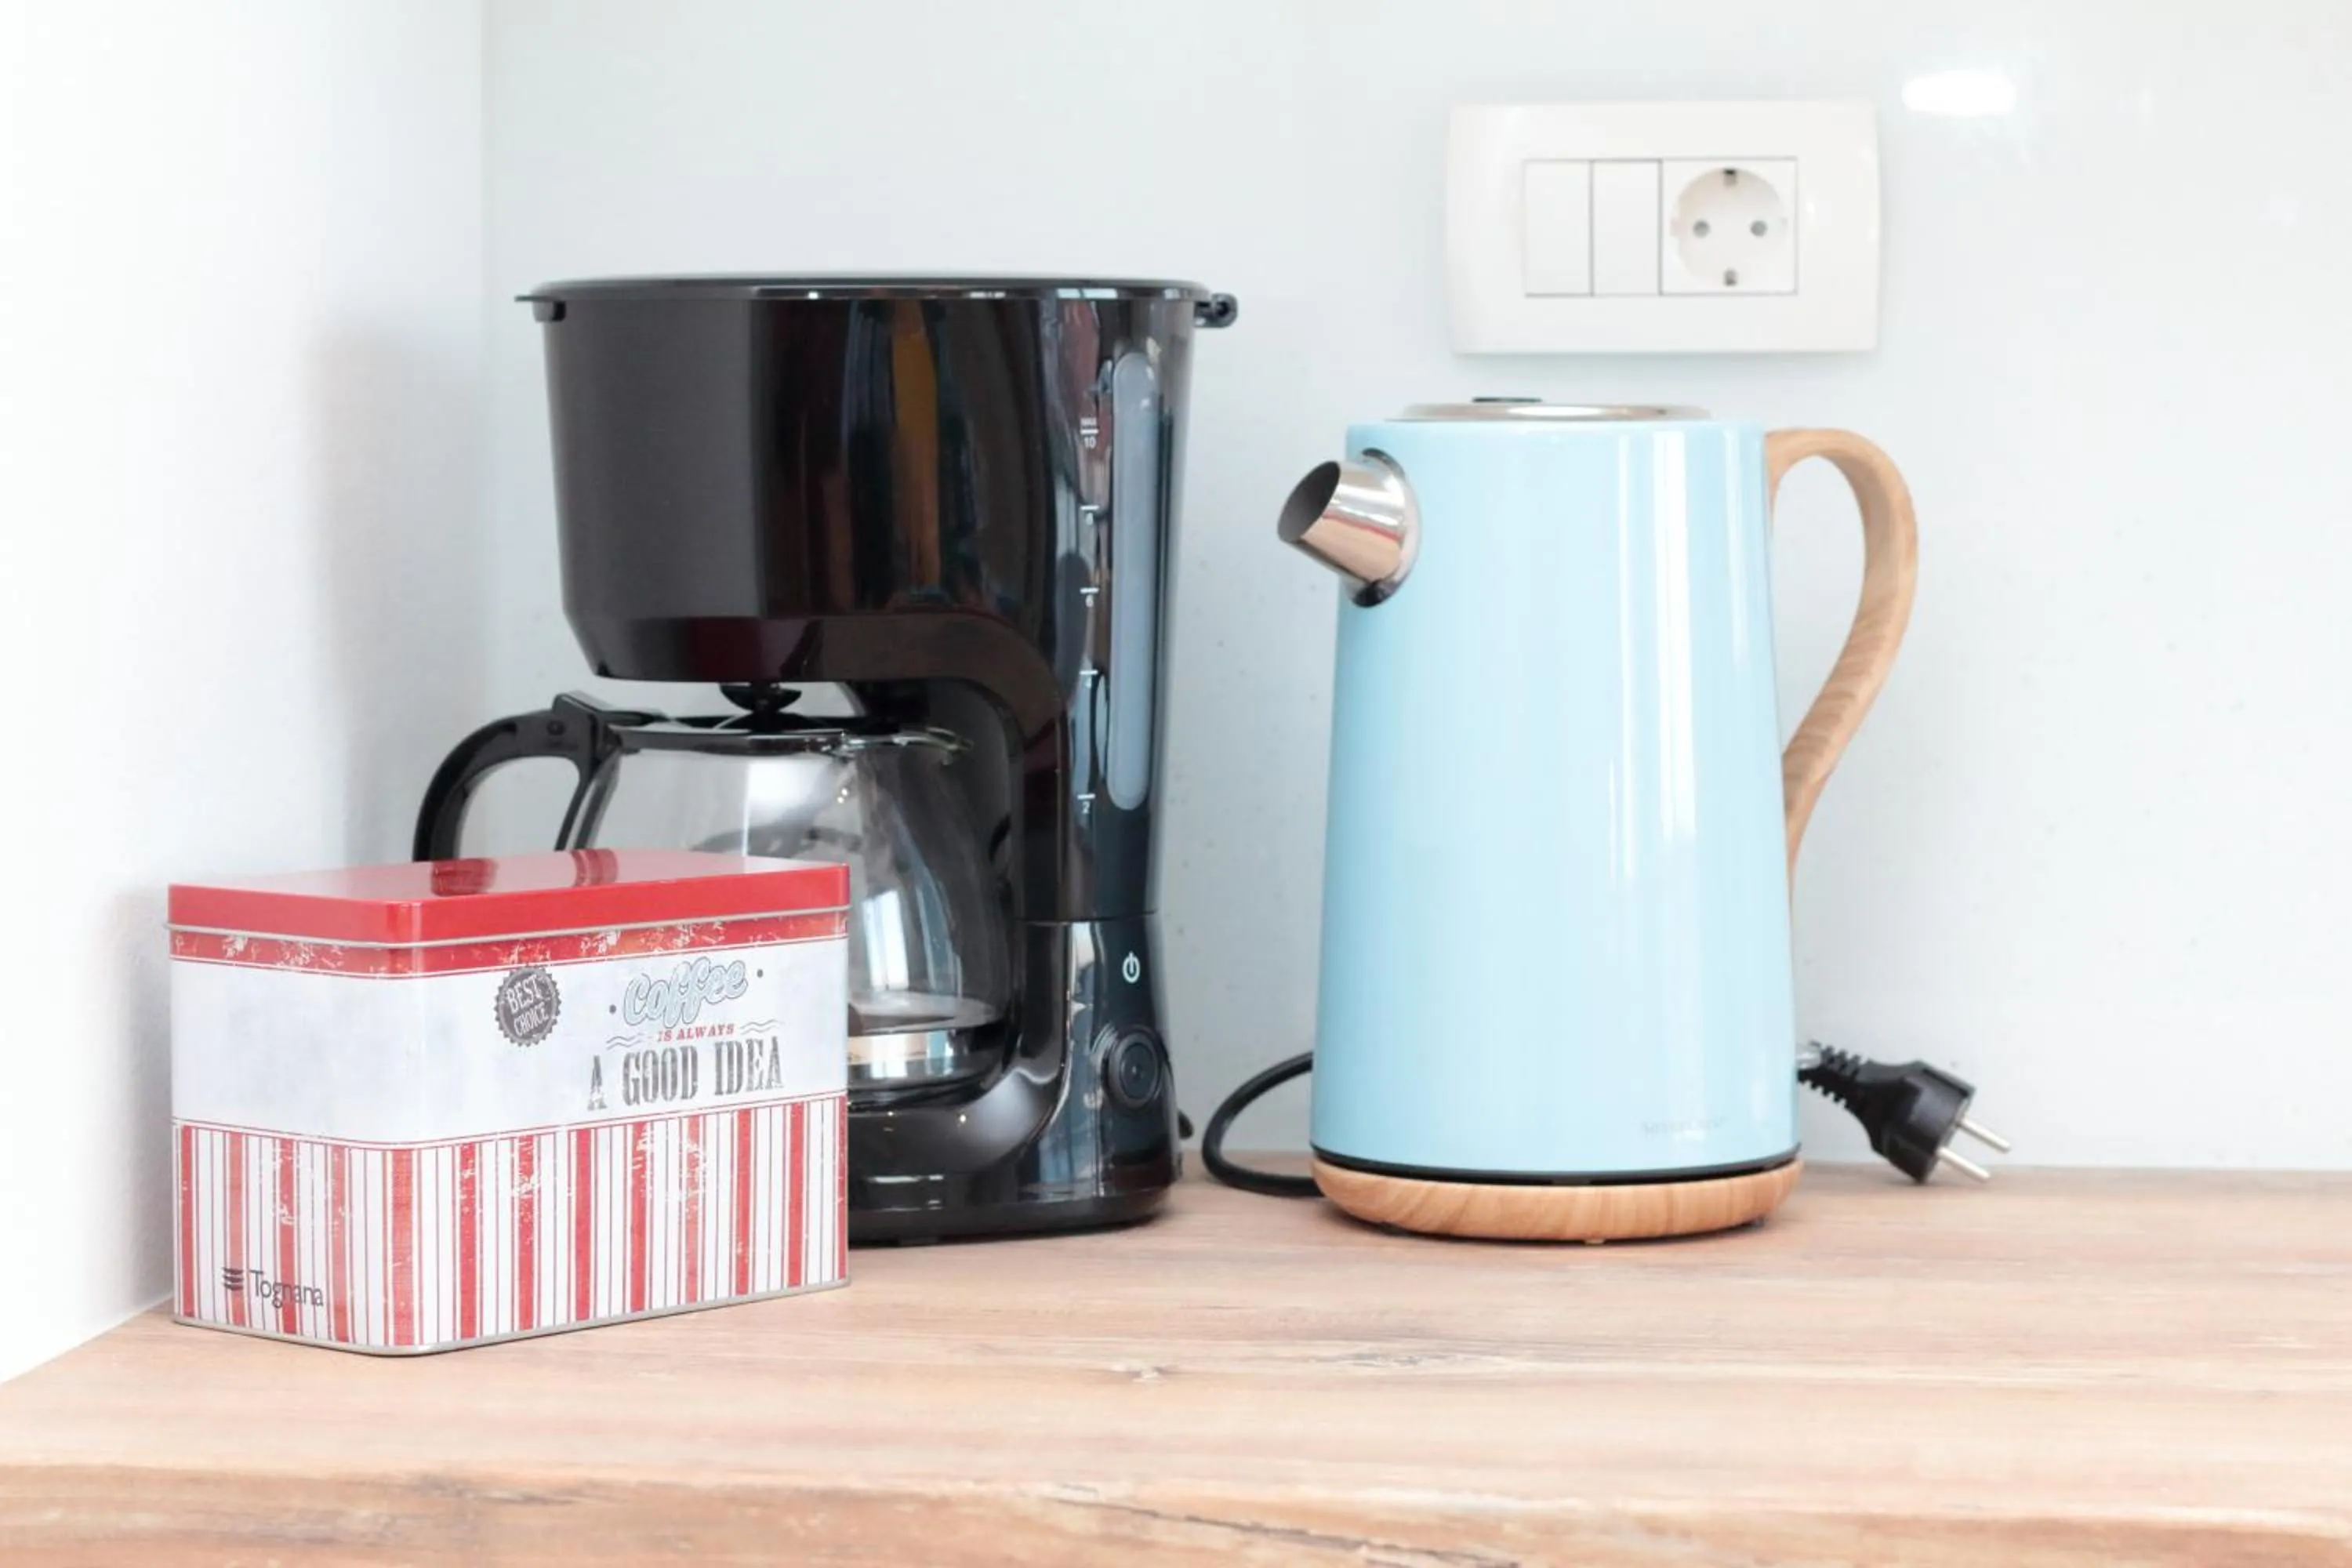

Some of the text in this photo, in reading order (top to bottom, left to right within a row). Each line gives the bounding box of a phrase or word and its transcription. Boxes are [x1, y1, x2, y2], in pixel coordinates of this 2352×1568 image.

[1081, 800, 1091, 815] 2
[506, 974, 543, 1014] BEST
[624, 956, 749, 1029] Coffee
[514, 1002, 550, 1036] CHOICE
[657, 1023, 735, 1043] IS ALWAYS
[587, 1036, 785, 1112] A GOOD IDEA
[249, 1269, 324, 1308] Tognana
